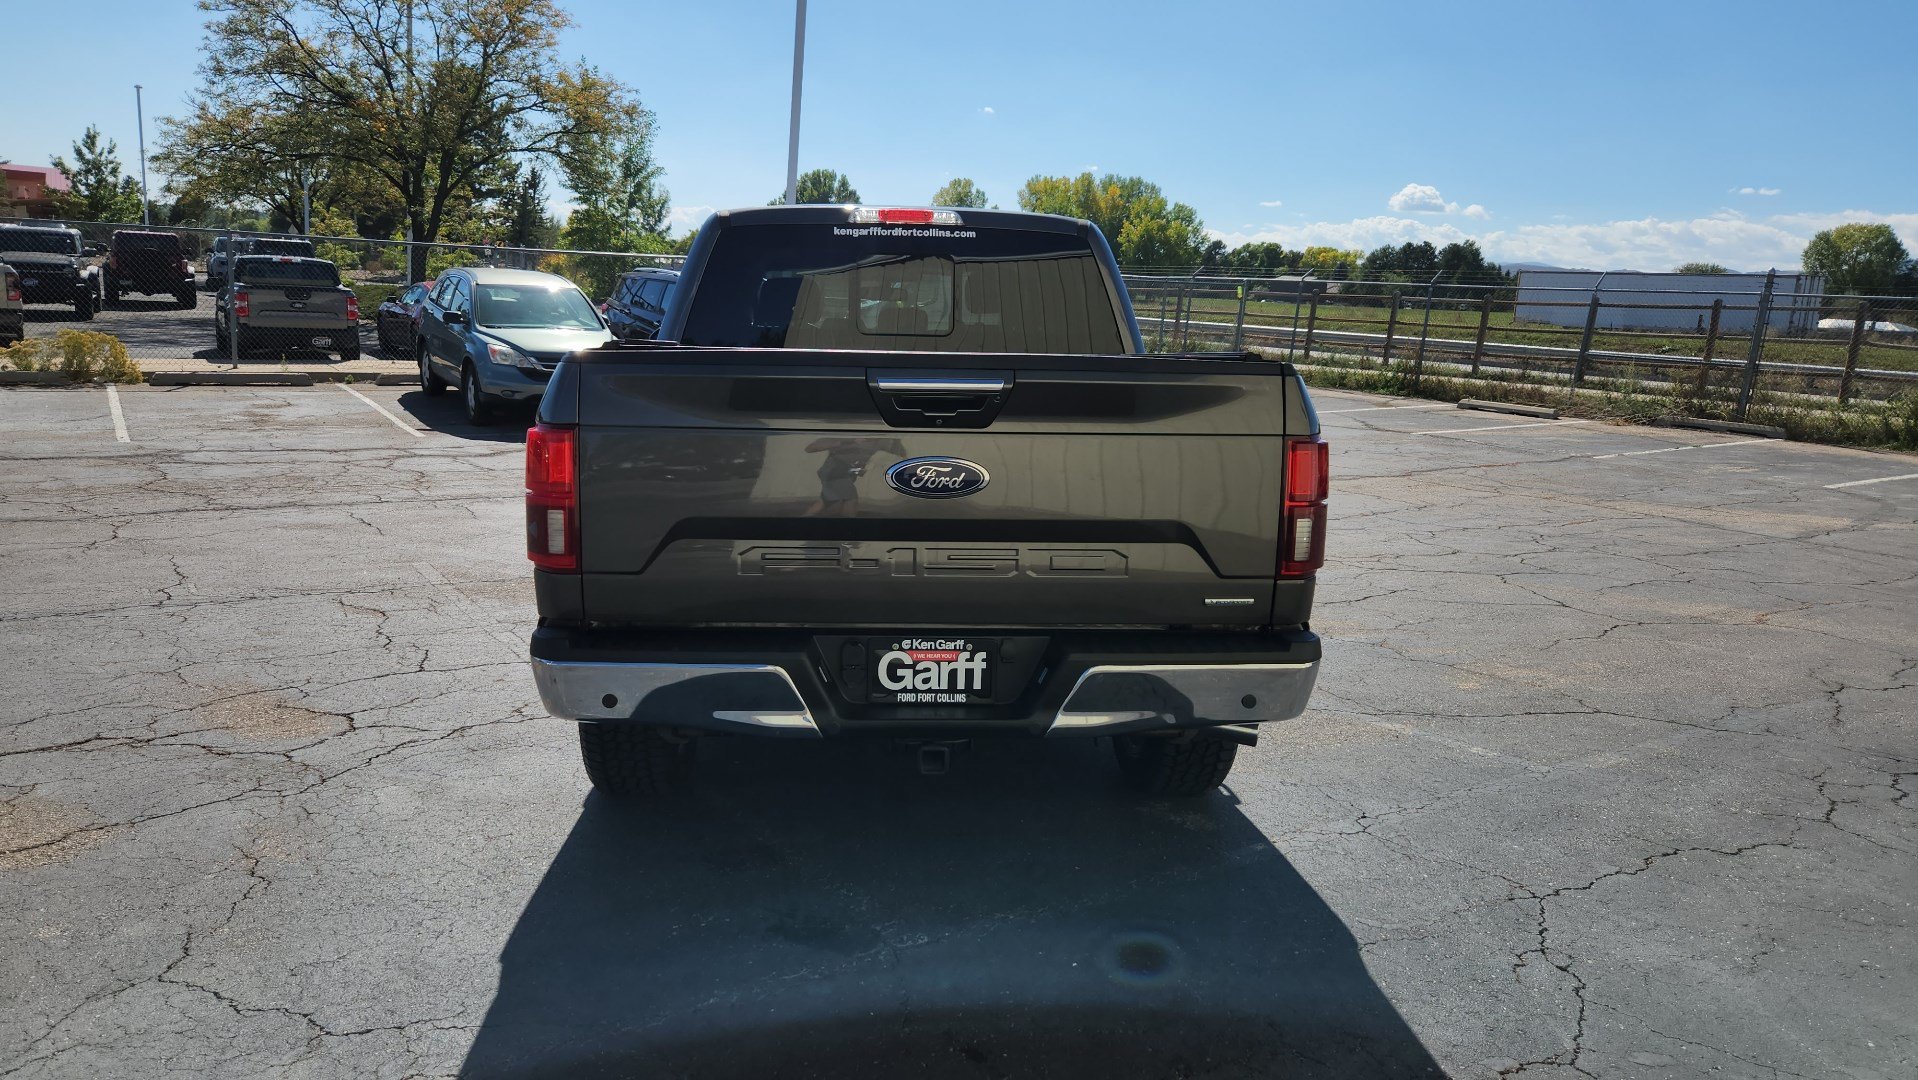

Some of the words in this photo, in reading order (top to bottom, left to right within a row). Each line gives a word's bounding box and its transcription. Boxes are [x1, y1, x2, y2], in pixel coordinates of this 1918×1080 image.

[833, 226, 976, 238] kengarfffordfortcollins.com
[910, 465, 965, 488] Ford
[737, 545, 1129, 578] F-150
[912, 638, 935, 650] Ken
[935, 639, 965, 650] Garff
[877, 650, 987, 691] Garff
[897, 693, 916, 703] FORD
[917, 693, 936, 703] FORT
[936, 693, 967, 703] COLLINS
